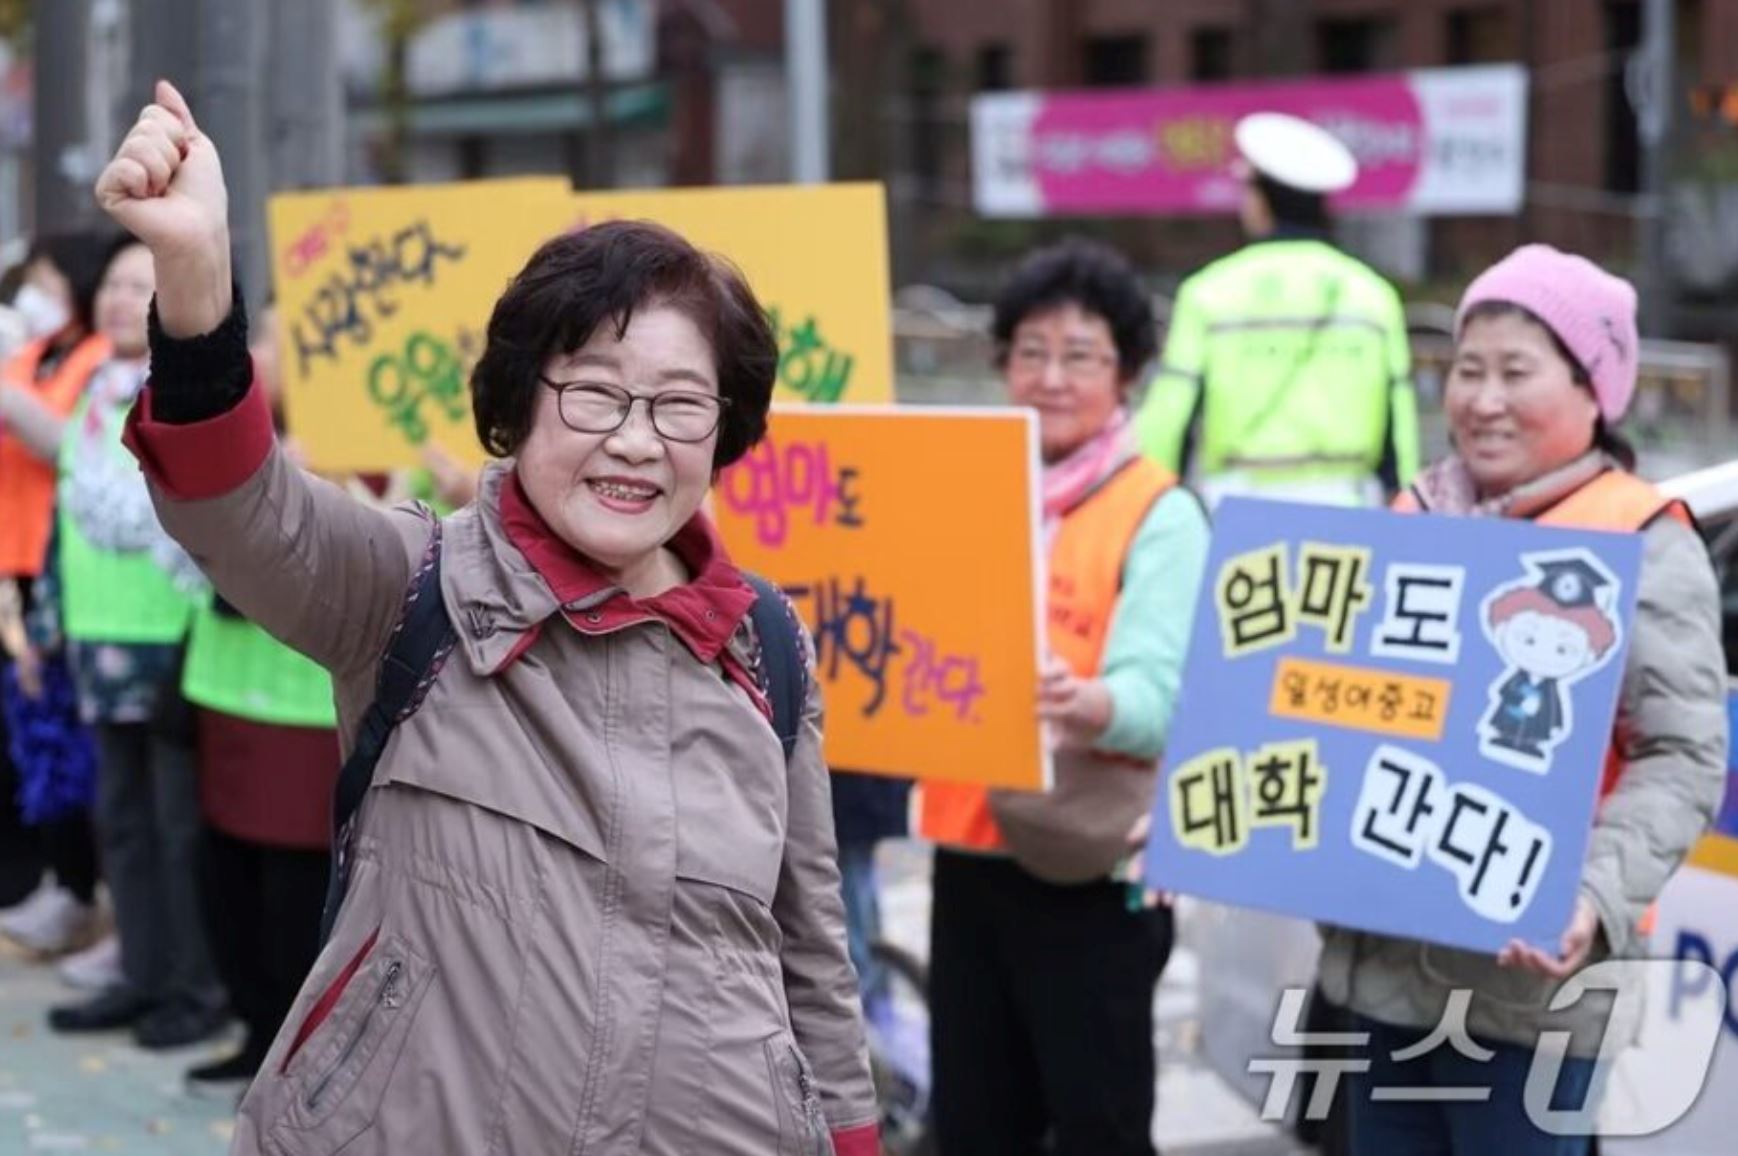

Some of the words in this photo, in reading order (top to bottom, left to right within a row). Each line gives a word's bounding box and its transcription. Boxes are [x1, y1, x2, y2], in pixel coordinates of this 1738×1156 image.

[720, 437, 863, 548] 엄마도
[783, 576, 902, 718] 대학
[1223, 554, 1453, 651] 엄마도
[1282, 669, 1437, 722] 일성여중고
[1176, 751, 1320, 849] 대학
[1360, 758, 1544, 910] 간다!
